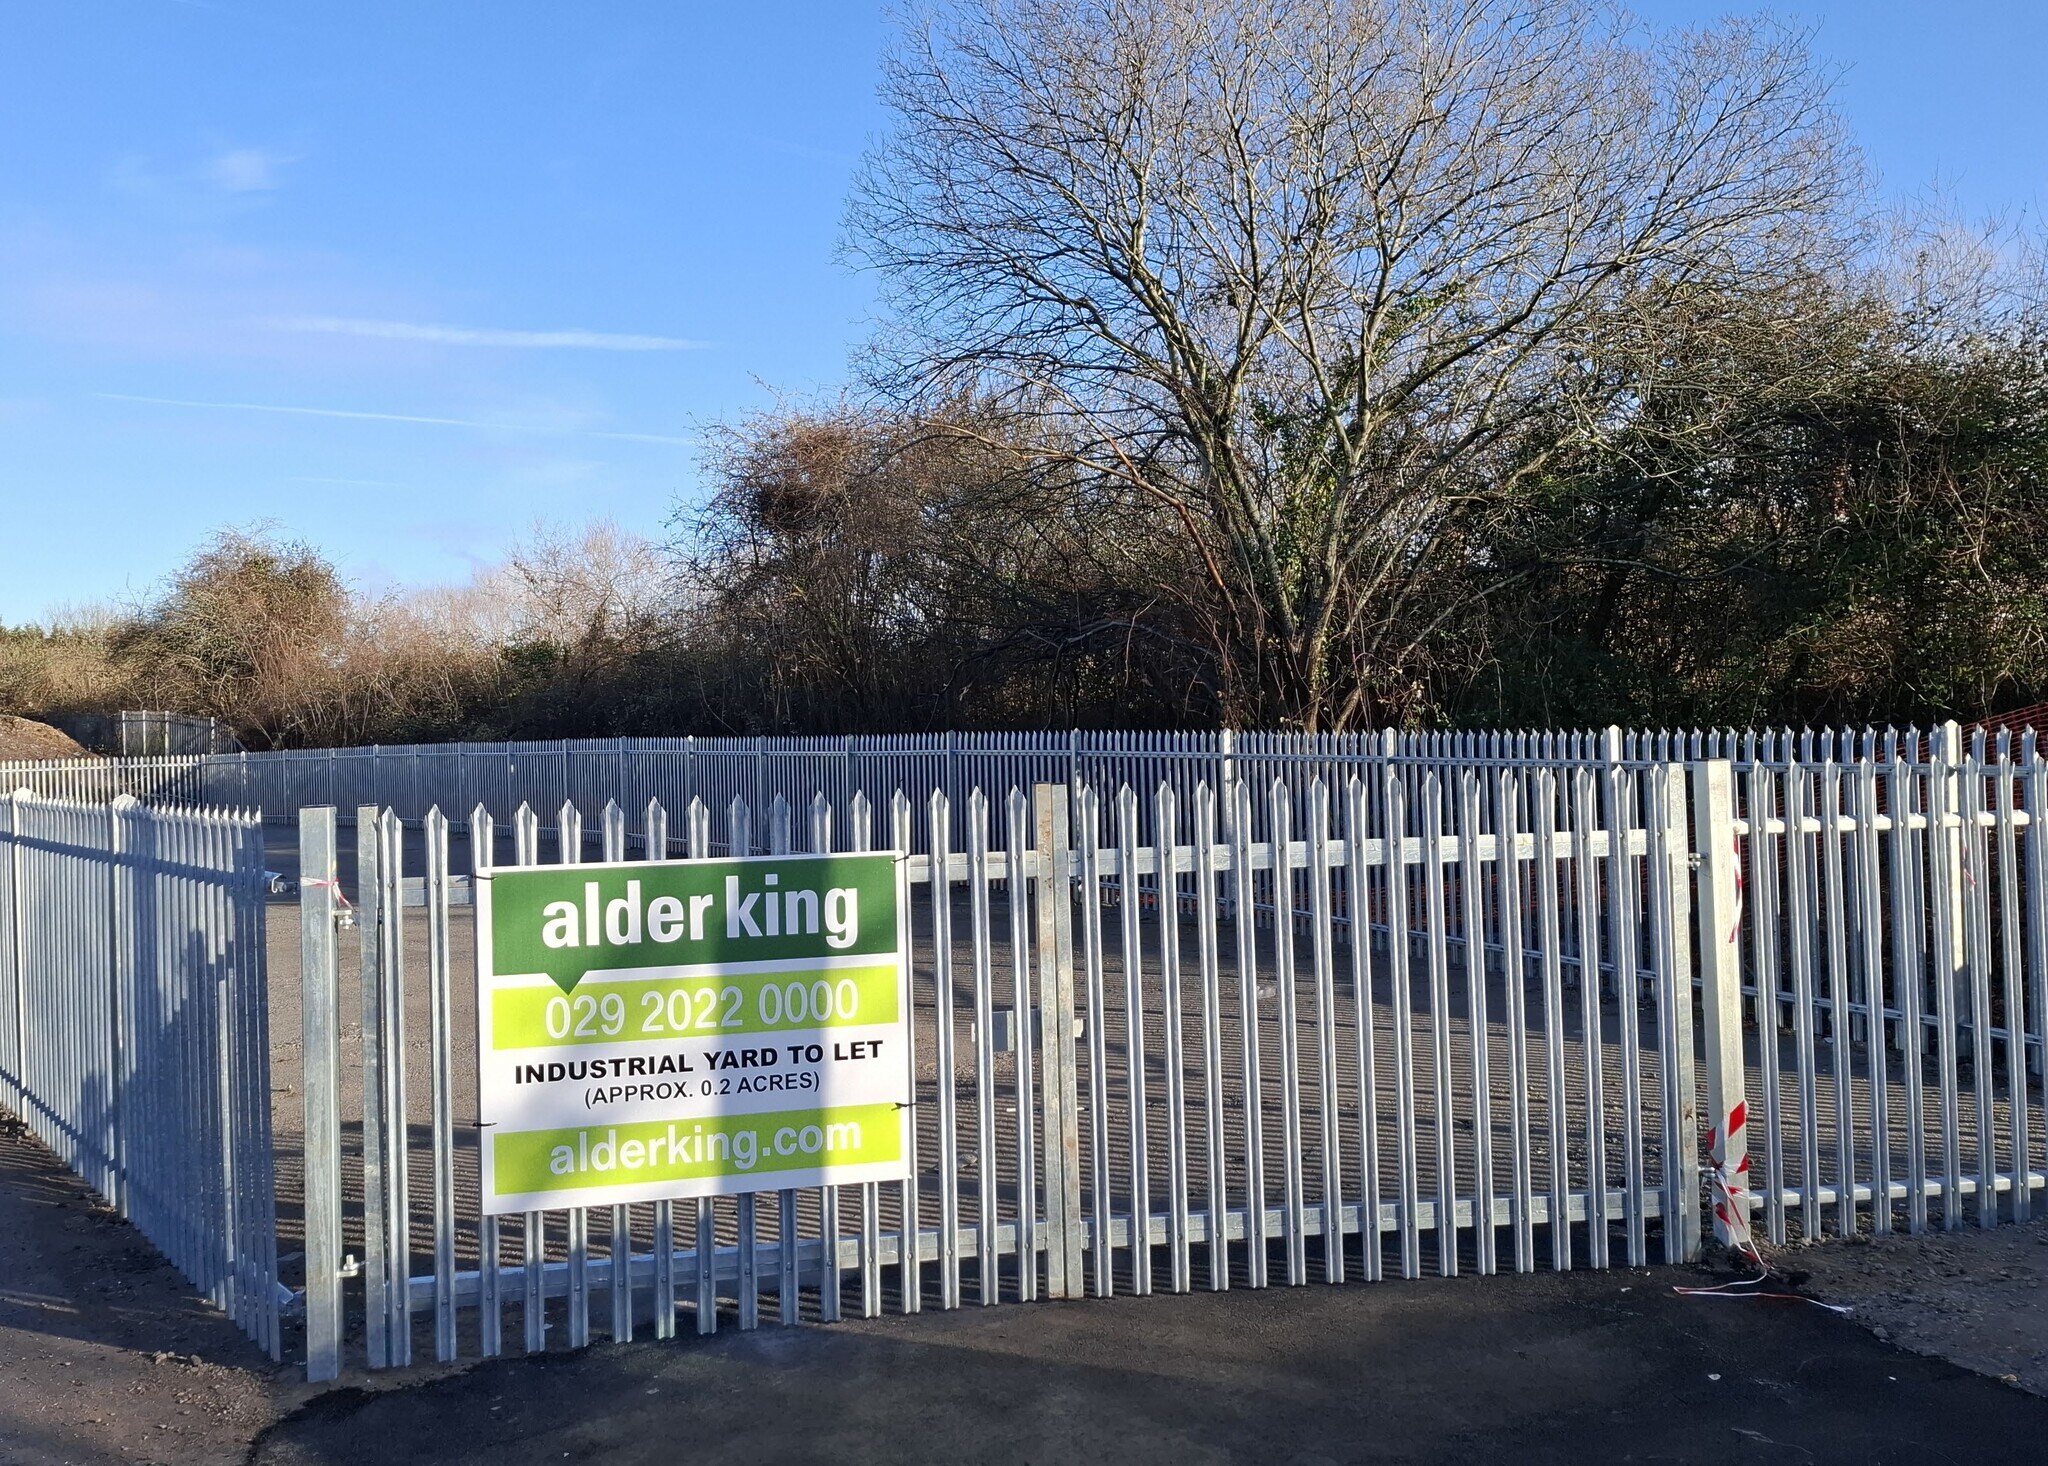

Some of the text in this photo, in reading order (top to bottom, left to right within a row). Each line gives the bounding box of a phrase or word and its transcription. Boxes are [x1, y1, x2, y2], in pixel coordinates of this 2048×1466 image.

[545, 978, 859, 1039] 029 2022 0000
[515, 1040, 884, 1085] INDUSTRIAL YARD TO LET
[584, 1071, 820, 1110] (APPROX. 0.2 ACRES)
[550, 1121, 862, 1175] alderking.com
